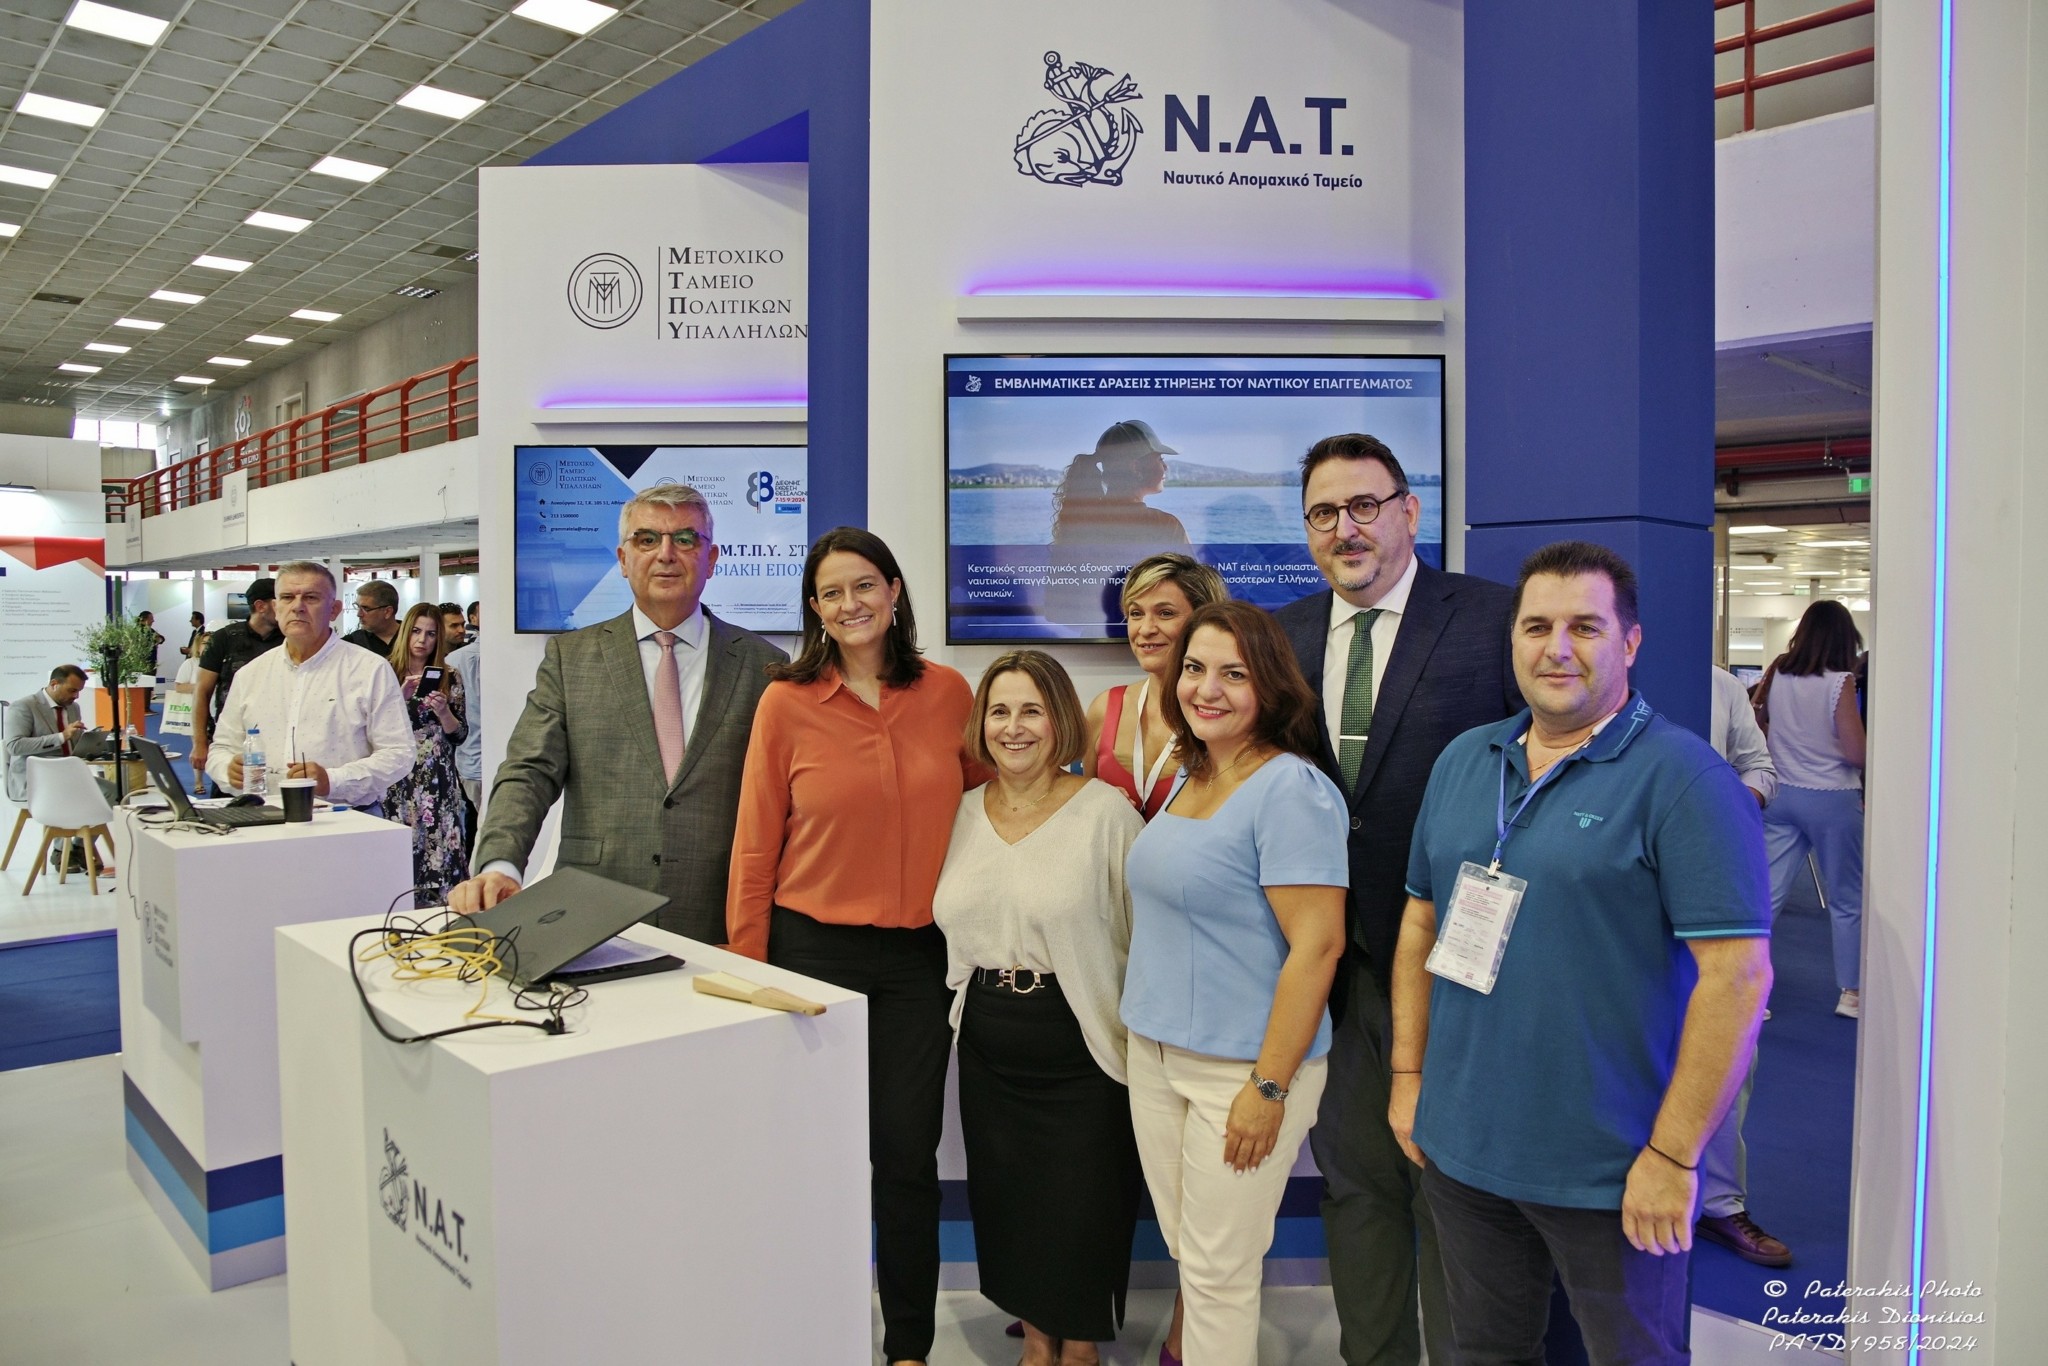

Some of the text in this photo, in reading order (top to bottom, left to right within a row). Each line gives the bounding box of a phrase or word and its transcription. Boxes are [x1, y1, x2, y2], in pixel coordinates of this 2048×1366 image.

[1163, 171, 1363, 190] Ναυτικό Απομαχικό Ταμείο
[994, 378, 1413, 390] ΕΜΒΛΗΜΑΤΙΚΕΣ ΔΡΑΣΕΙΣ ΣΤΗΡΙΞΗΣ ΤΟΥ ΝΑΥΤΙΚΟΥ ΕΠΑΓΓΕΛΜΑΤΟΣ
[968, 564, 1015, 575] Κεντρικός
[1018, 563, 1077, 574] στρατηγικός
[1080, 562, 1113, 574] άξονας
[1240, 562, 1262, 572] είναι
[1265, 564, 1271, 573] η
[968, 576, 1010, 586] ναυτικού
[1013, 575, 1080, 588] επαγγέλματος
[1082, 577, 1098, 586] και
[1100, 578, 1106, 587] η
[1278, 575, 1319, 586] Ελλήνων
[968, 588, 1015, 600] γυναικών.
